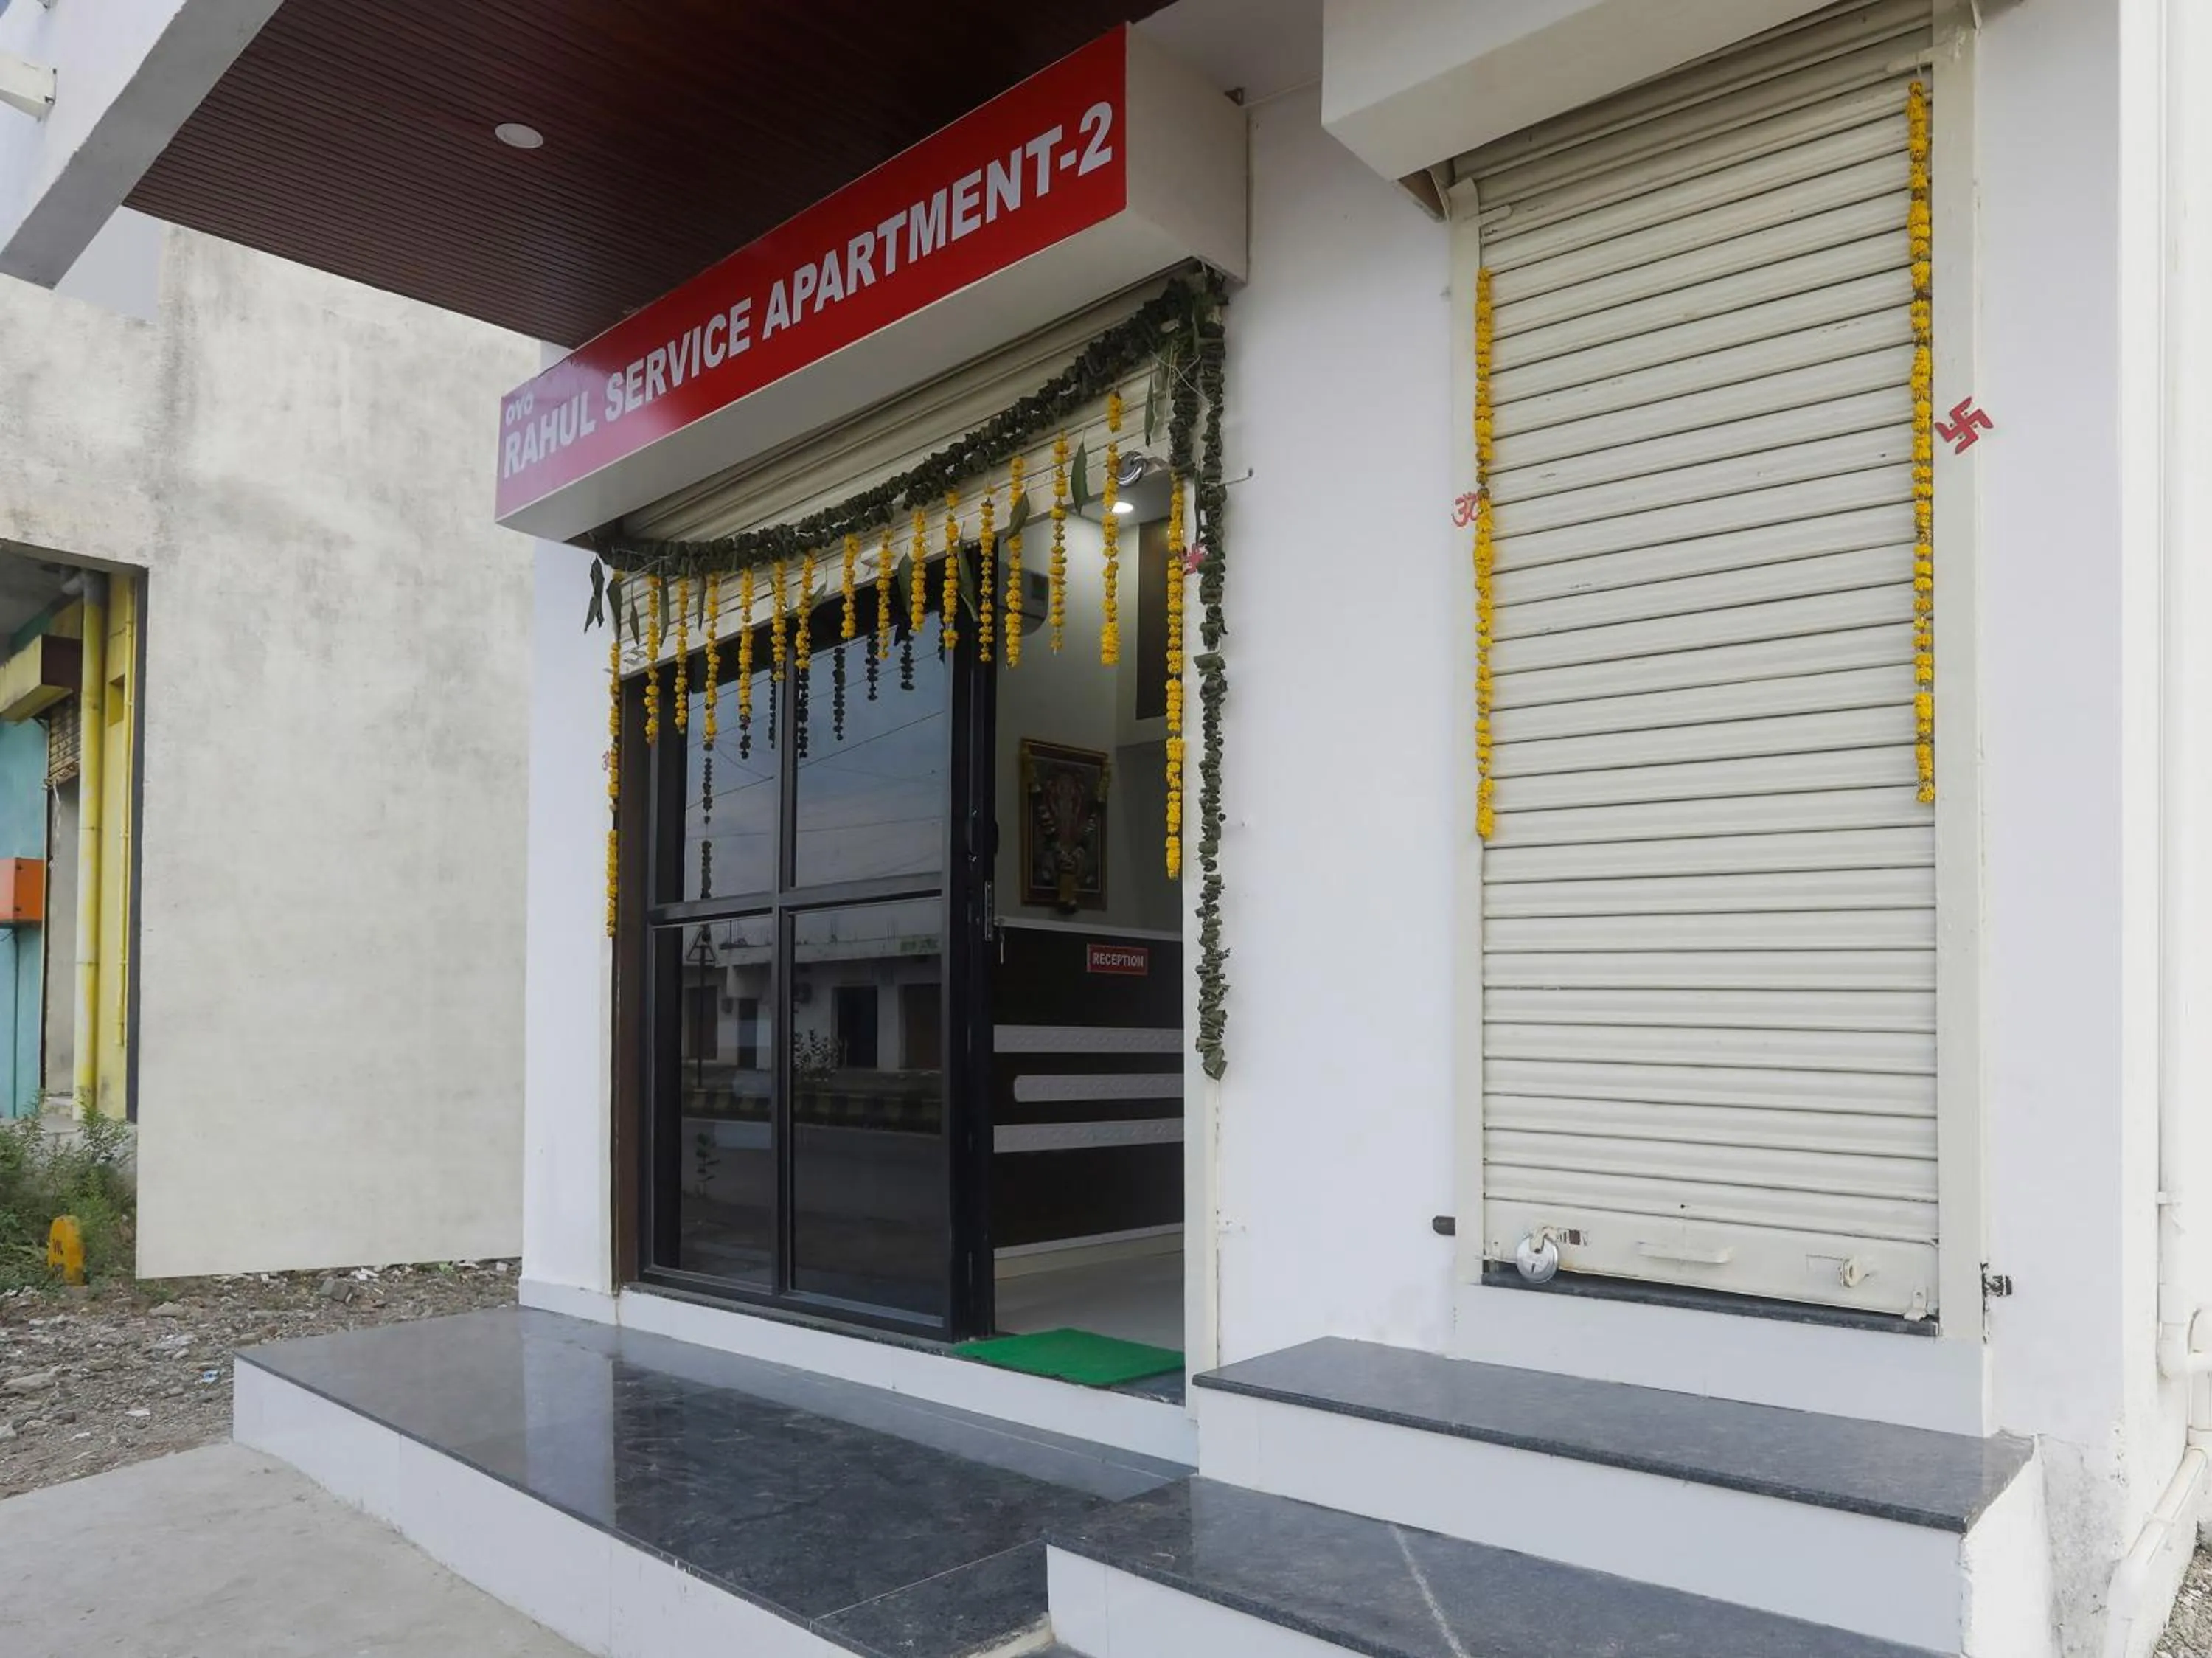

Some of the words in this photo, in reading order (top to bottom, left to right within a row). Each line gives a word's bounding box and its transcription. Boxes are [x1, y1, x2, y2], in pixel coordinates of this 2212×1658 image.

[504, 391, 596, 478] RAHUL
[605, 298, 751, 422] SERVICE
[762, 102, 1112, 340] APARTMENT-2
[505, 391, 533, 426] OYO
[1093, 952, 1144, 967] RECEPTION
